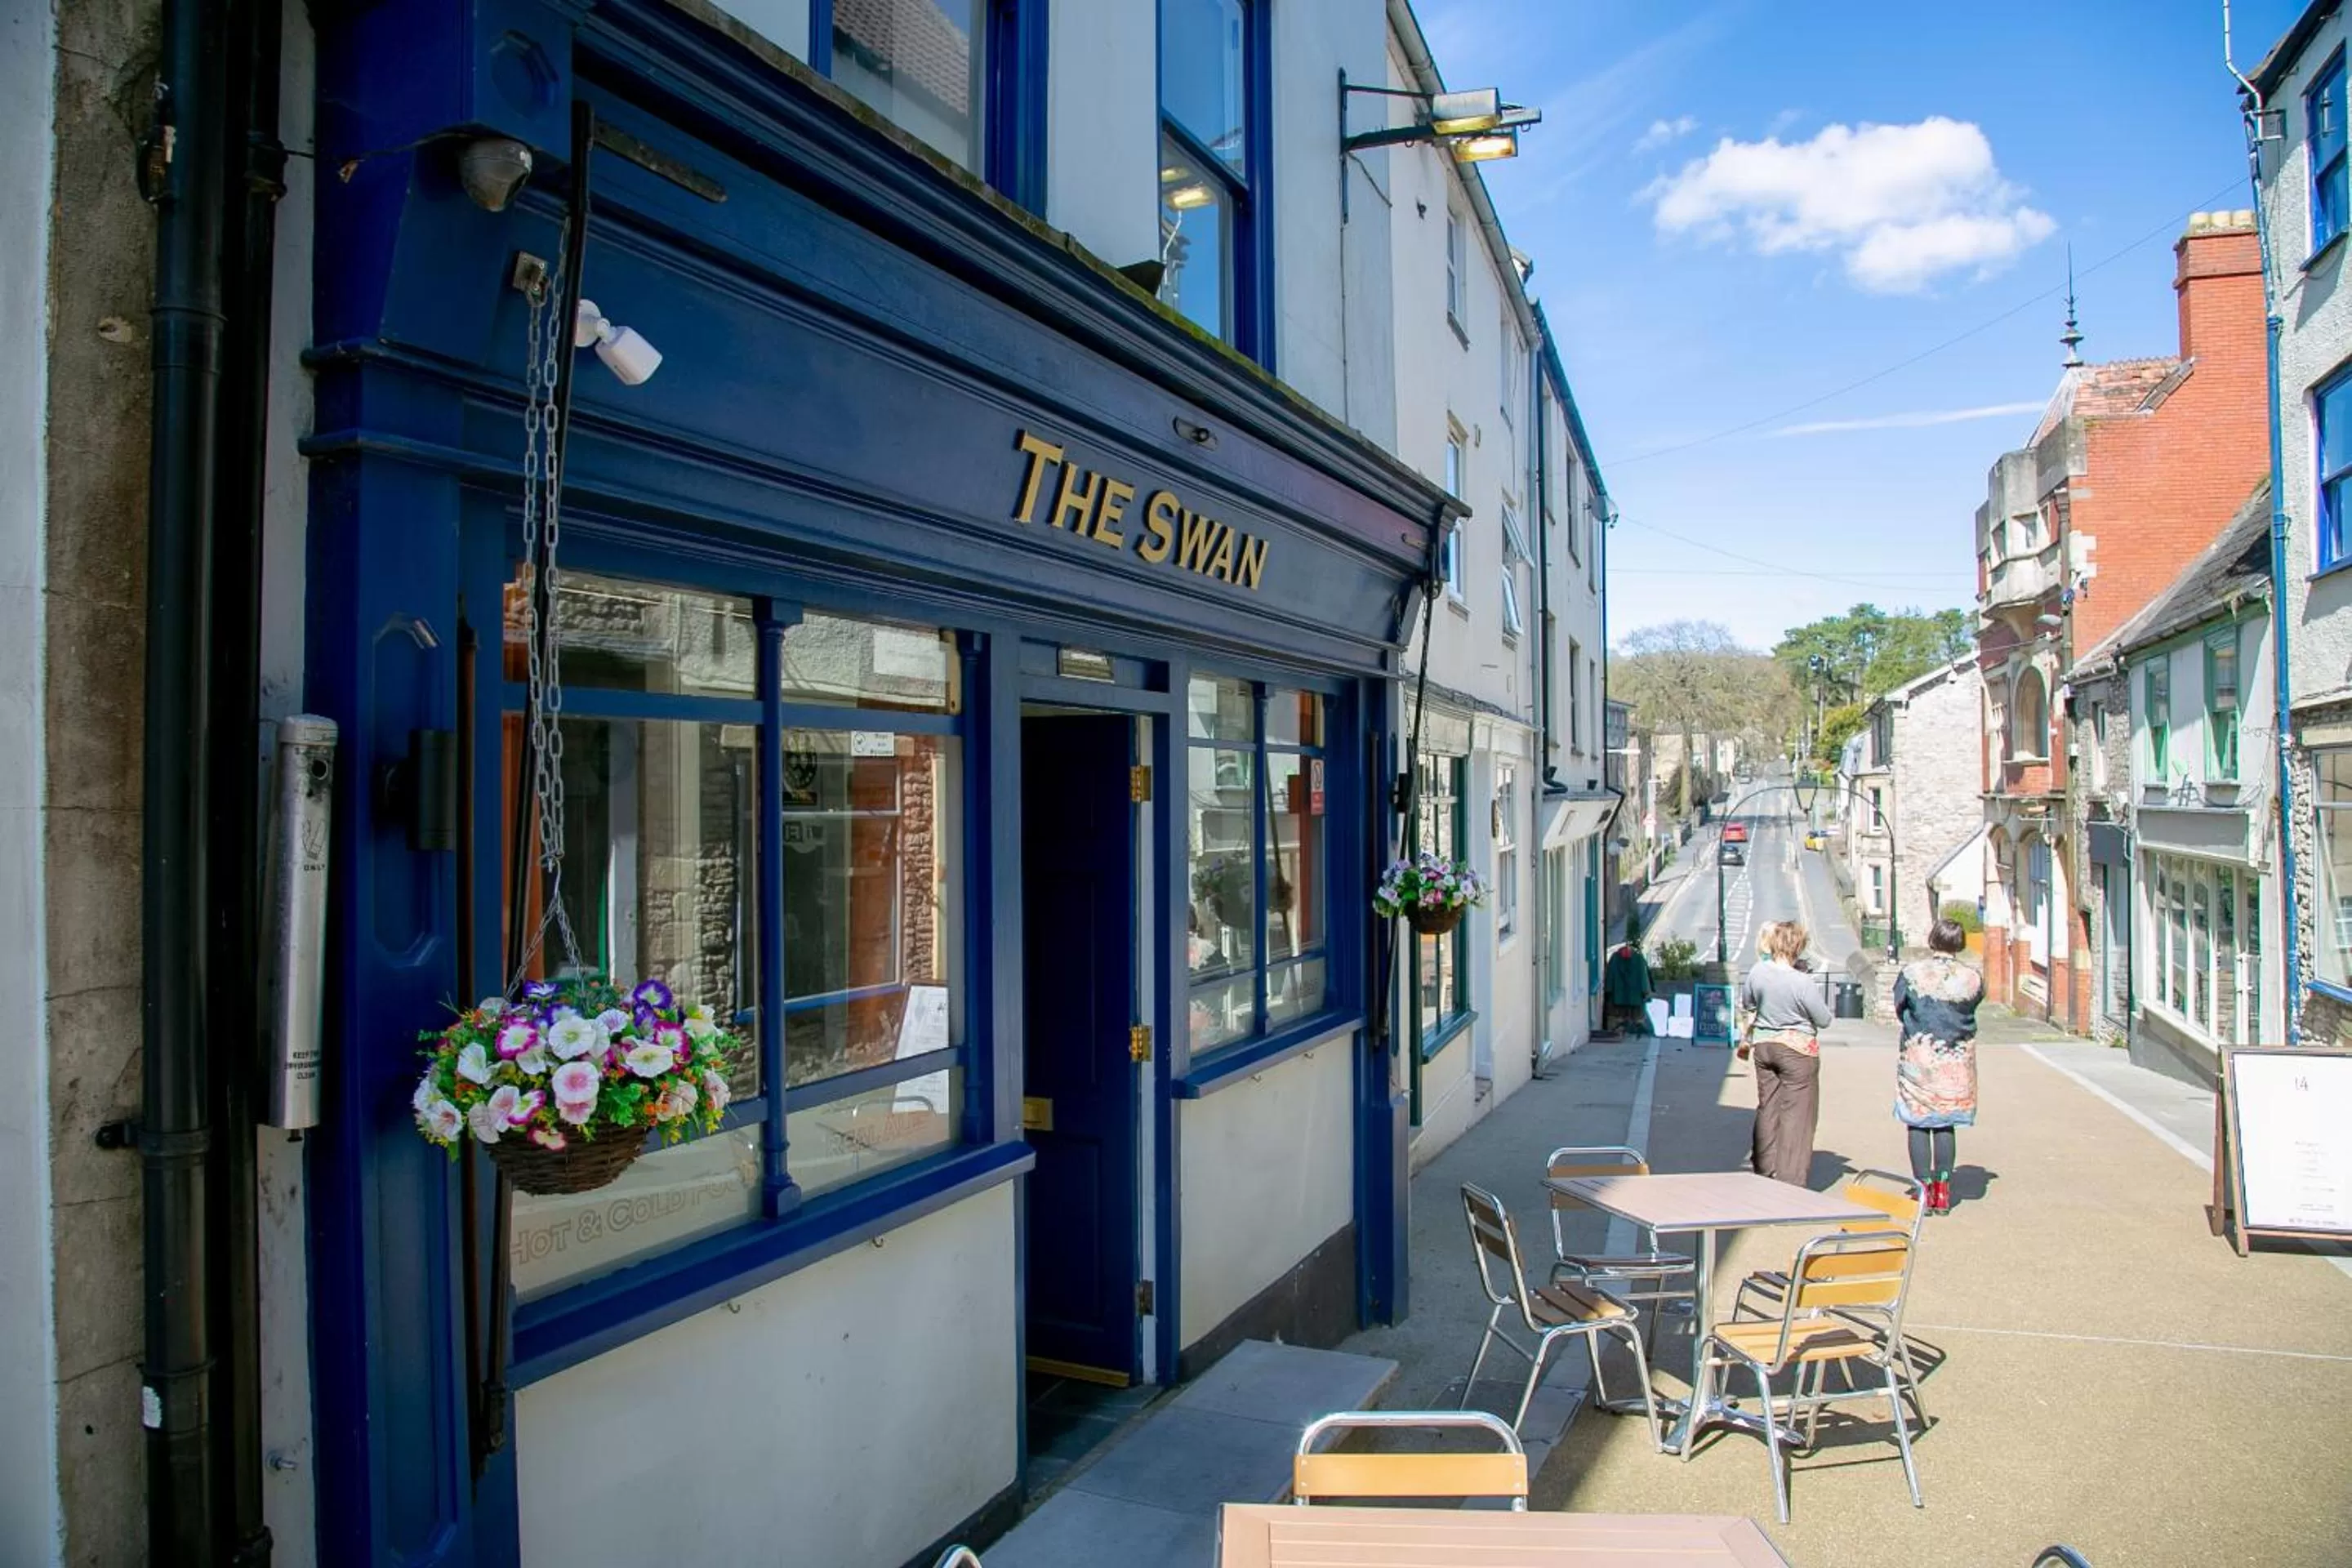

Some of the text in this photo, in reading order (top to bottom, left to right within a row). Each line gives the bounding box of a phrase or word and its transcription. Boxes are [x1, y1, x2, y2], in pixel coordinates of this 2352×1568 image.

[1013, 430, 1269, 590] THE SWAN
[509, 1218, 572, 1265] HOT
[577, 1209, 603, 1243] &
[607, 1190, 687, 1232] COLD
